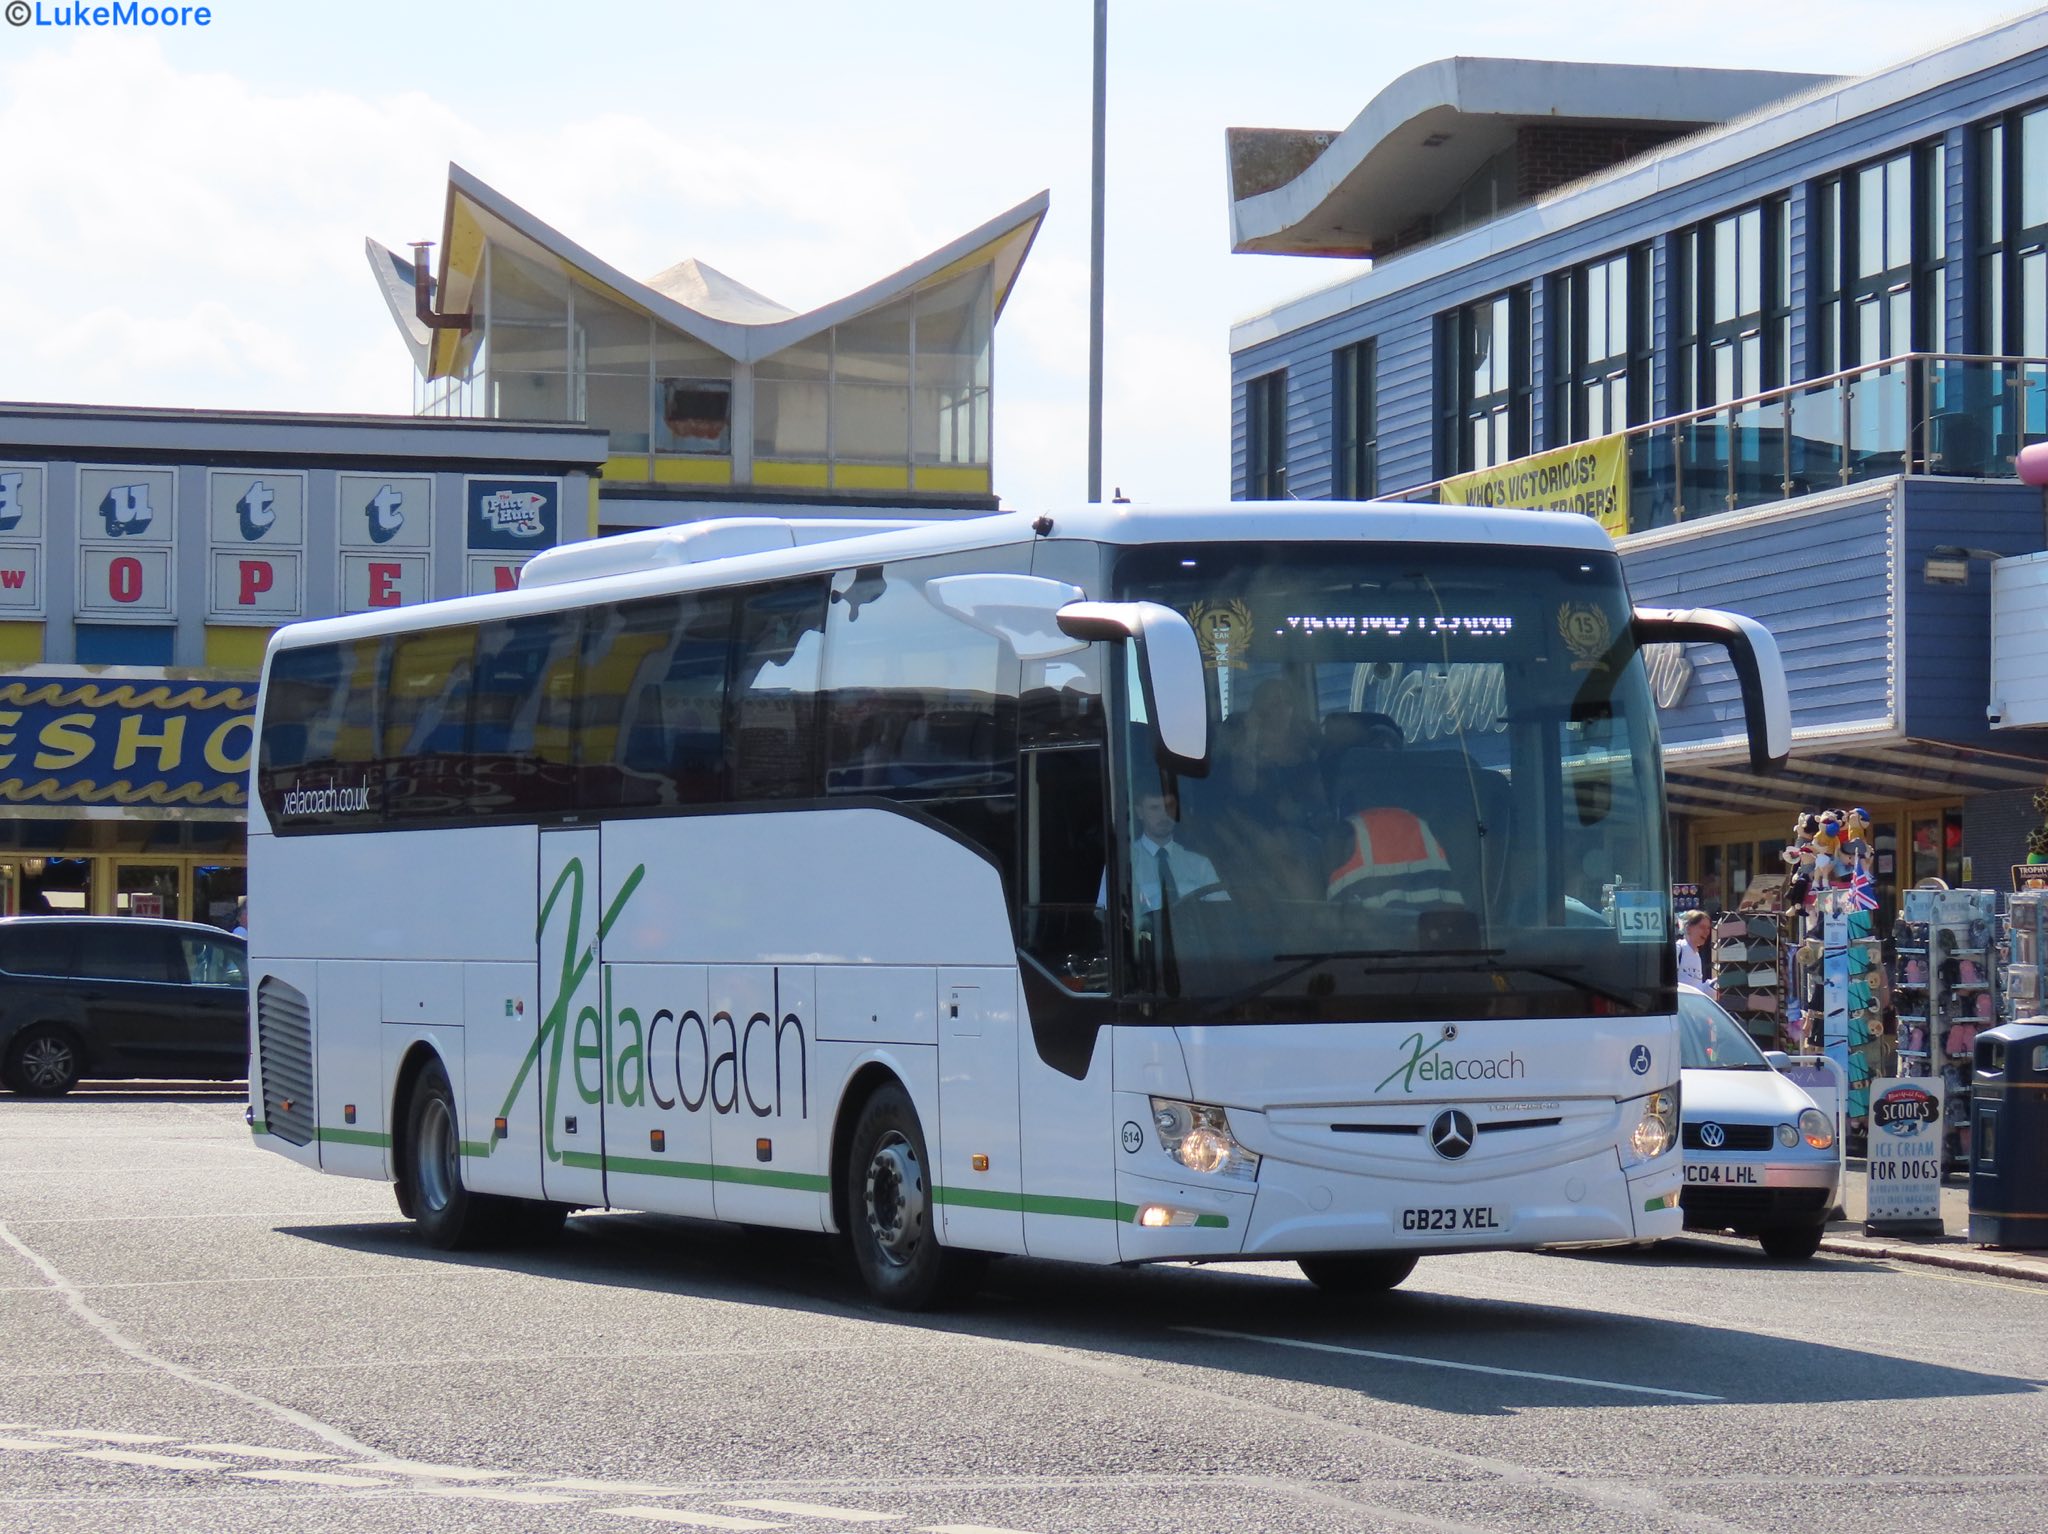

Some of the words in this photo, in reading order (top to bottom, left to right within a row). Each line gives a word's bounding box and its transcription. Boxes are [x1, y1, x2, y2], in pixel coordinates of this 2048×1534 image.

[1465, 479, 1505, 507] WHO'S
[1508, 454, 1596, 502] VICTORIOUS?
[487, 500, 523, 513] Putt
[498, 509, 535, 524] Hutt
[1208, 614, 1231, 632] 15
[1575, 616, 1594, 634] 15
[283, 774, 370, 815] xelacoach.co.uk
[1623, 911, 1660, 930] LS12
[489, 856, 808, 1163] Xelacoach
[1375, 1032, 1525, 1094] Xelacoach
[1123, 1131, 1140, 1144] 614
[1875, 1142, 1892, 1158] ICE
[1897, 1141, 1934, 1158] CREAM
[1683, 1165, 1720, 1183] C04
[1725, 1166, 1757, 1184] LHL
[1870, 1161, 1896, 1180] FOR
[1902, 1160, 1938, 1179] DOGS
[1403, 1208, 1457, 1231] GB23
[1462, 1207, 1499, 1229] XEL
